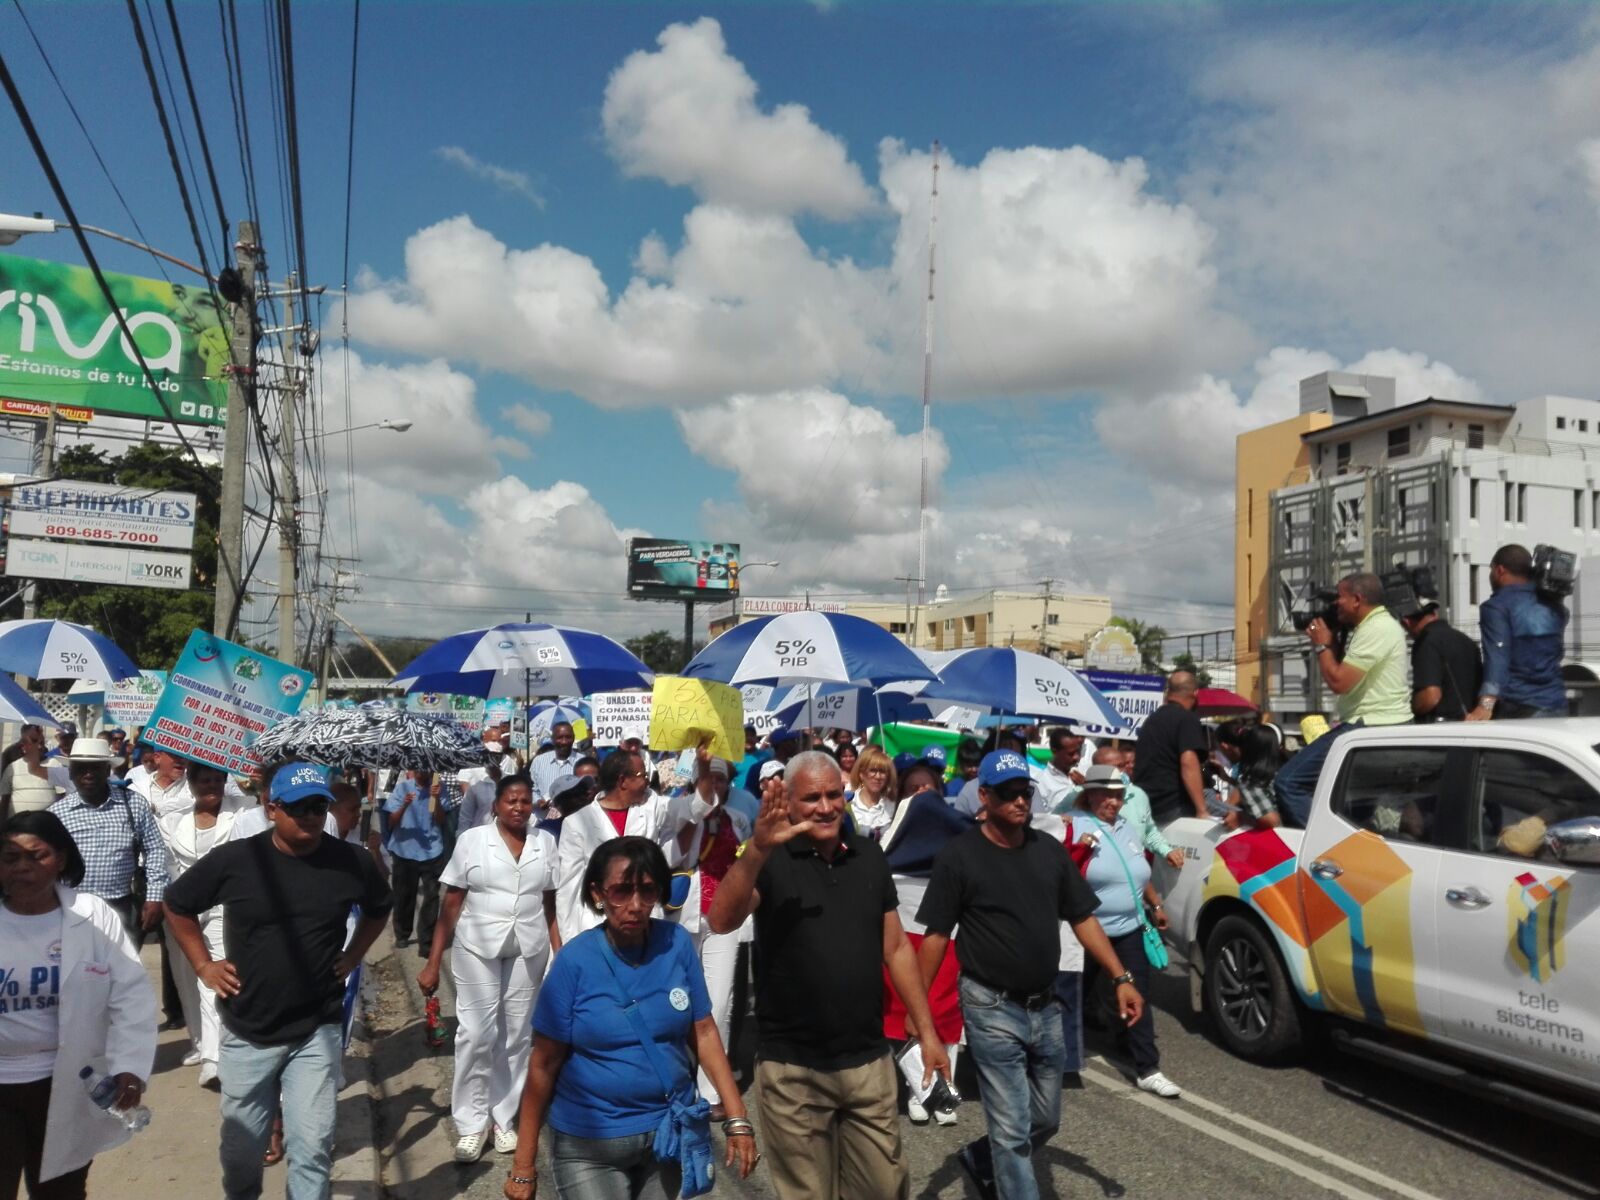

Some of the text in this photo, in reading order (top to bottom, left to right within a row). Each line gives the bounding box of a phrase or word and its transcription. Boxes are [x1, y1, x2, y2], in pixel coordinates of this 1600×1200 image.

[0, 289, 182, 374] iva
[0, 355, 81, 378] Estamos
[88, 367, 110, 382] de
[116, 371, 135, 386] tu
[45, 524, 158, 543] 809-685-7000
[70, 559, 122, 572] EMERSON
[145, 562, 183, 579] YORK
[744, 600, 769, 612] PLAZA
[539, 648, 559, 660] 5%
[774, 639, 817, 655] 5%
[60, 652, 88, 665] 5%
[779, 656, 808, 667] PIB
[173, 674, 222, 699] COORDINADORA
[222, 692, 231, 703] DE
[232, 697, 242, 707] LA
[242, 700, 263, 714] SALUD
[263, 708, 275, 718] DEL
[239, 684, 247, 694] LA
[674, 680, 716, 705] 5%
[1034, 678, 1070, 697] 5%
[105, 701, 133, 710] AUMENTO
[606, 695, 636, 705] UNASED
[1045, 695, 1069, 707] PIB
[184, 696, 267, 733] POR LA PRESERVACION
[596, 715, 609, 723] EN
[653, 703, 700, 726] PARA
[193, 715, 207, 728] DEL
[208, 721, 227, 735] IDSS
[234, 731, 244, 741] EL
[596, 725, 623, 740] POR
[157, 718, 193, 738] RECHAZO
[192, 731, 204, 743] DE
[204, 735, 214, 747] LA
[215, 738, 230, 751] LEY
[229, 744, 244, 756] QUE
[145, 729, 155, 740] EL
[155, 733, 192, 753] SERVICIO
[191, 746, 228, 766] NACIONAL
[228, 757, 239, 770] DE
[13, 996, 32, 1012] LA
[1518, 989, 1559, 1014] tele
[1495, 1006, 1585, 1043] sistema
